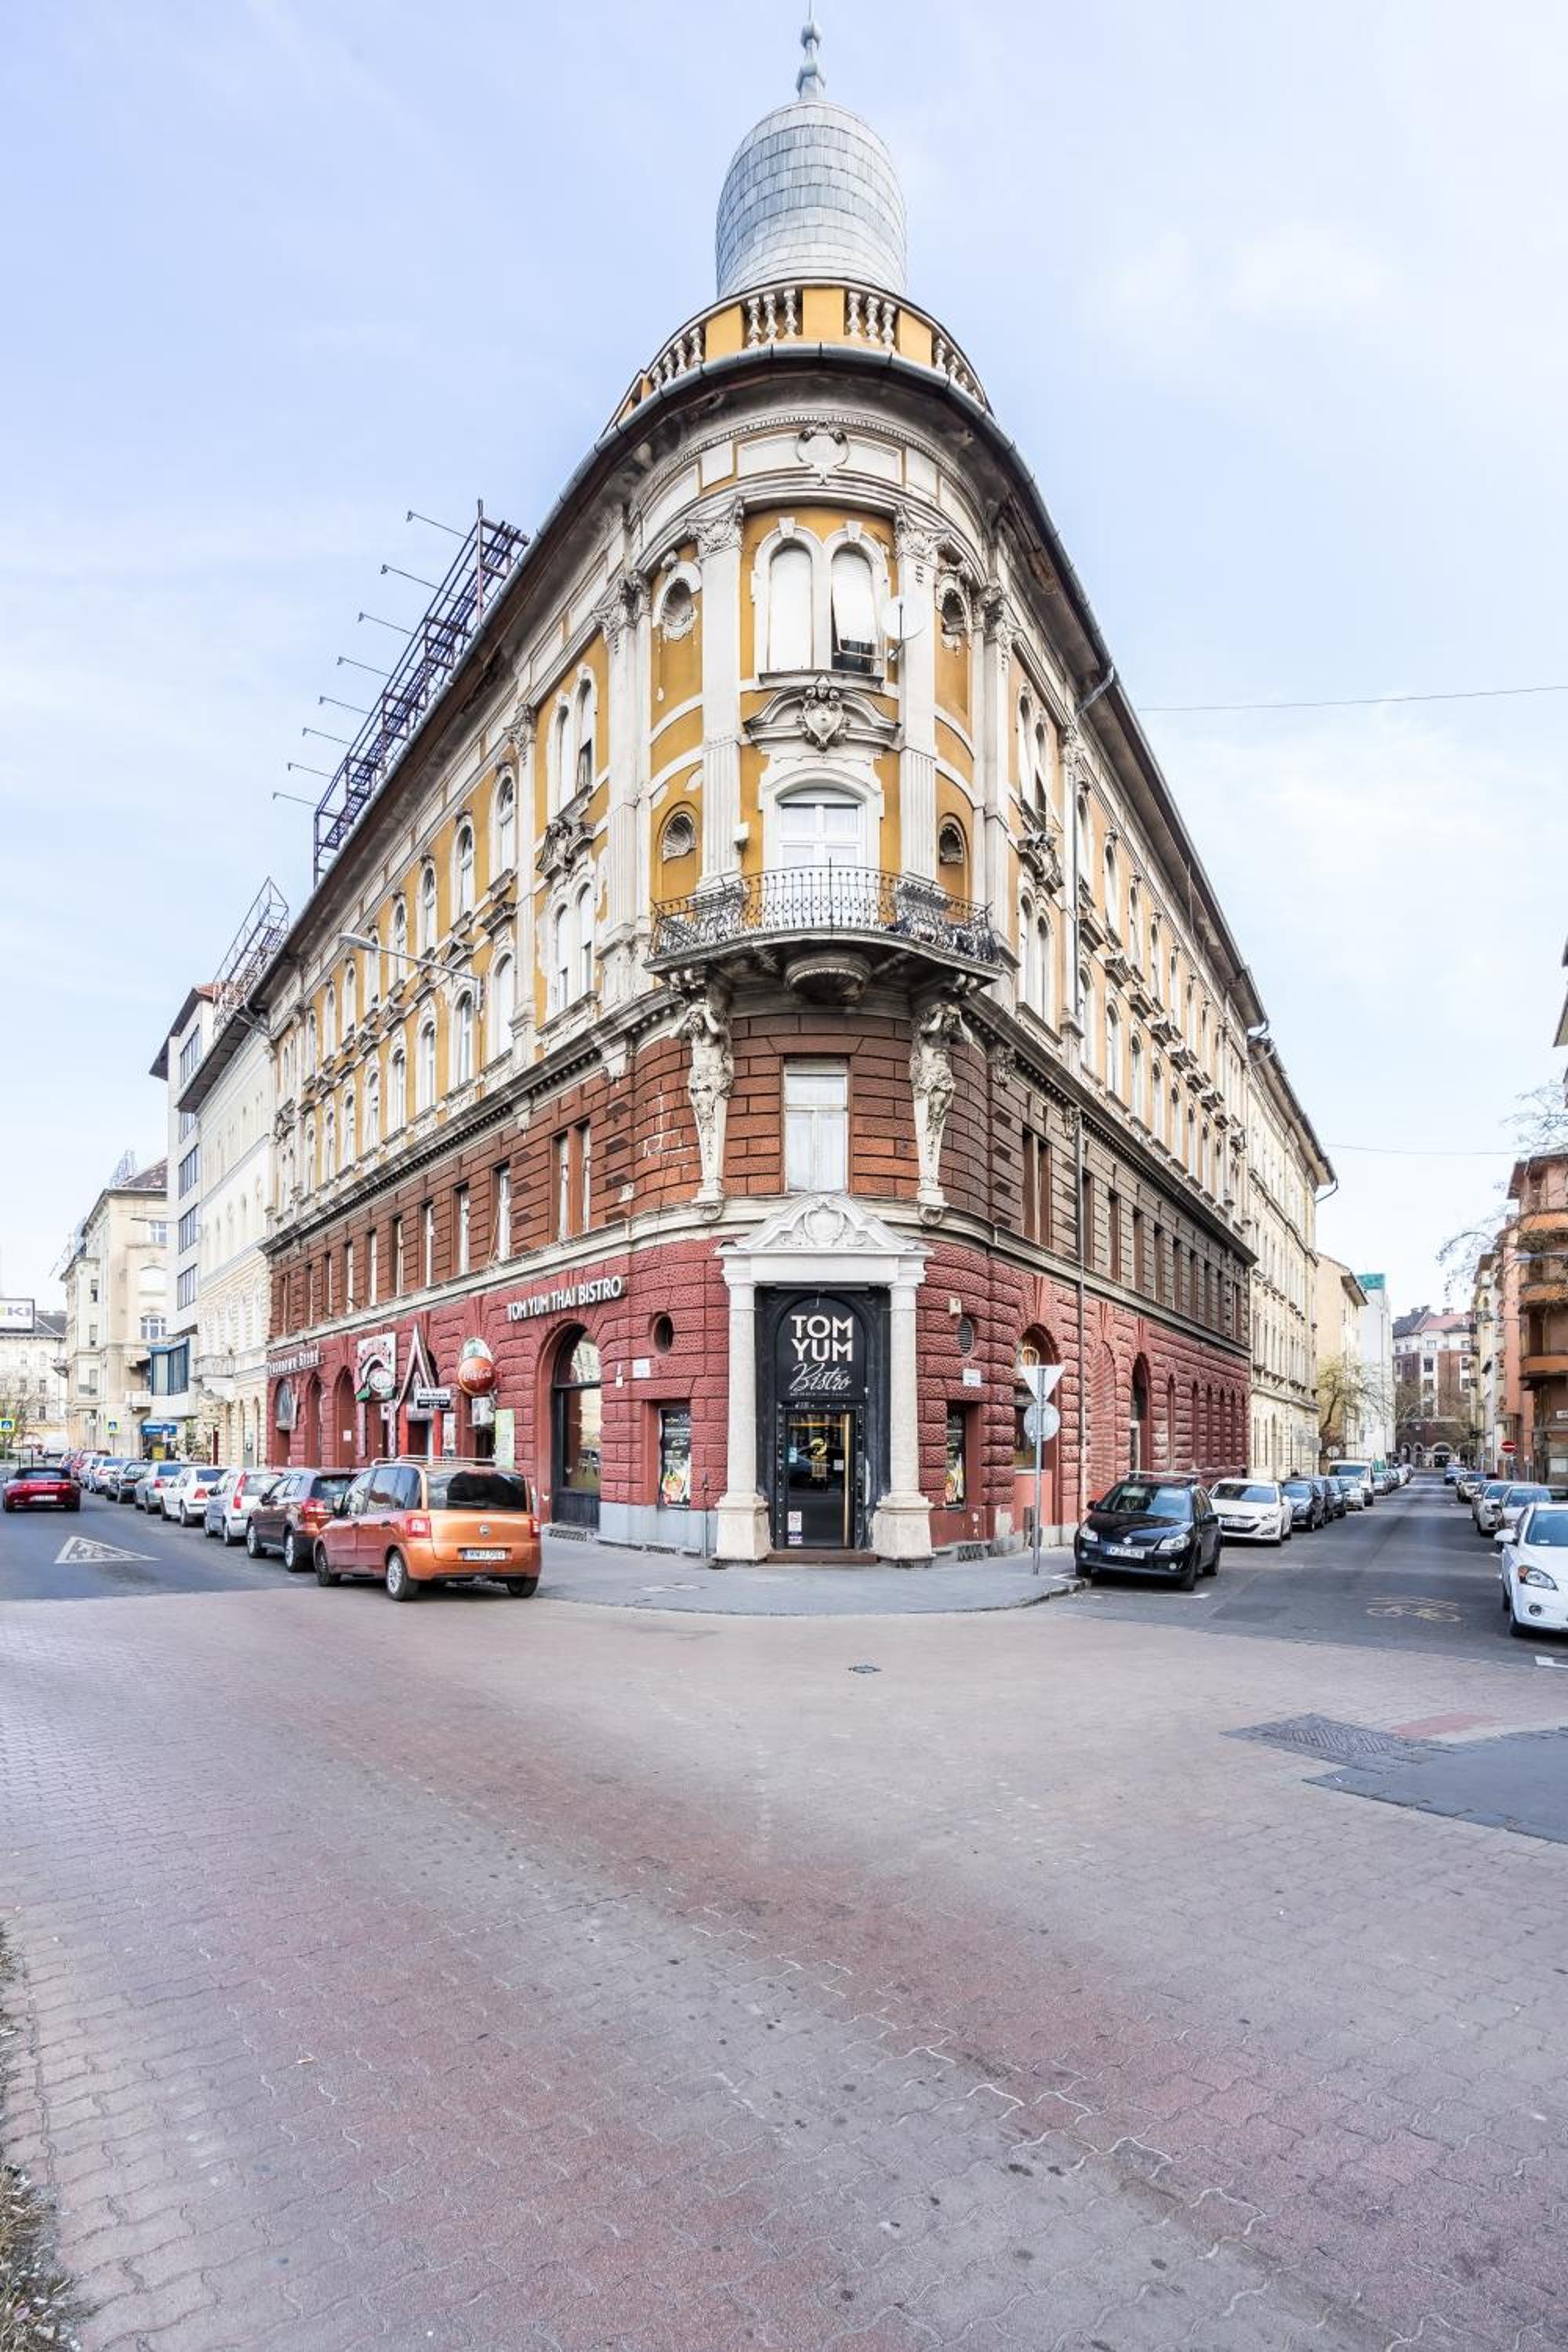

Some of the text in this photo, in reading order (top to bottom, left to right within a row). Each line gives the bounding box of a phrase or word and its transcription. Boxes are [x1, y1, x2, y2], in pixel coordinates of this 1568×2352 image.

[506, 1276, 622, 1321] TOM YUM THAI BISTRO
[791, 1316, 853, 1338] TOM
[791, 1339, 853, 1361] YUM
[789, 1363, 851, 1392] Bistro
